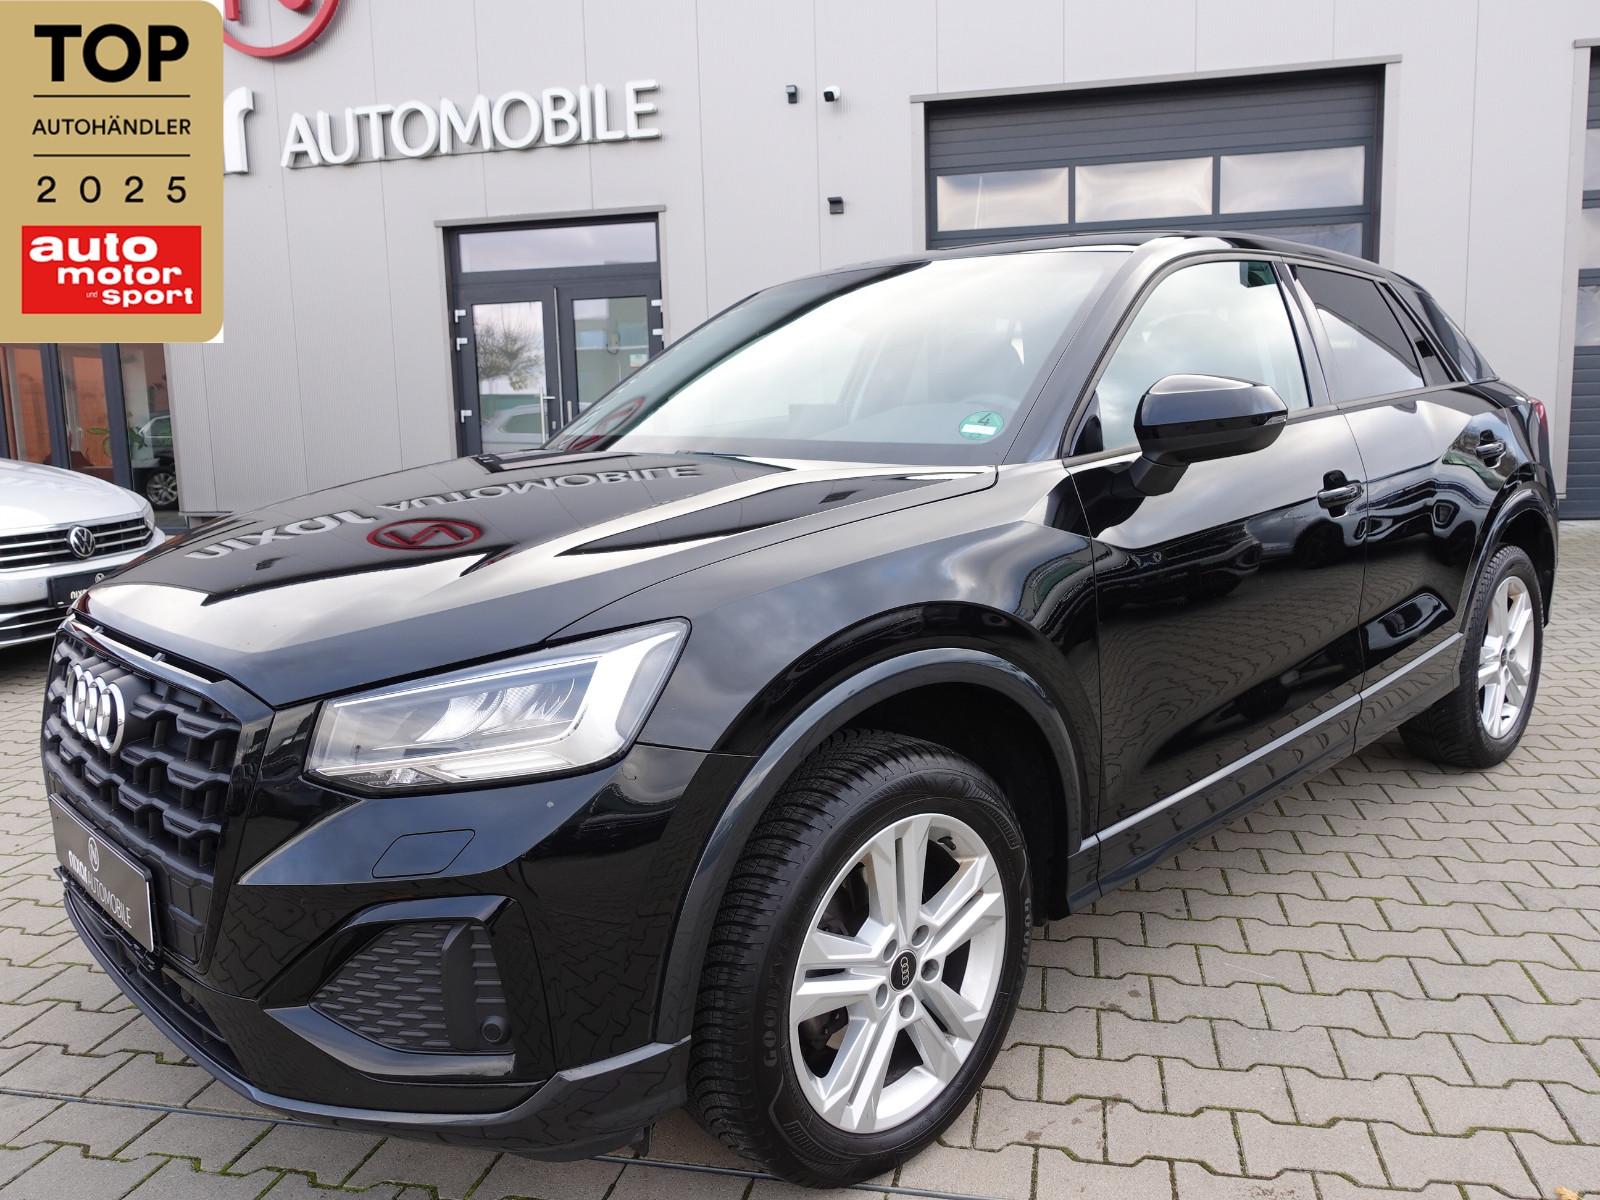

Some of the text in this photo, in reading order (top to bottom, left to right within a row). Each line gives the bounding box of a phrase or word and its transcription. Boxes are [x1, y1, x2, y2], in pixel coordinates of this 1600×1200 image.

[280, 79, 662, 168] AUTOMOBILE
[977, 412, 993, 426] 4
[87, 872, 132, 928] AUTOMOBILE
